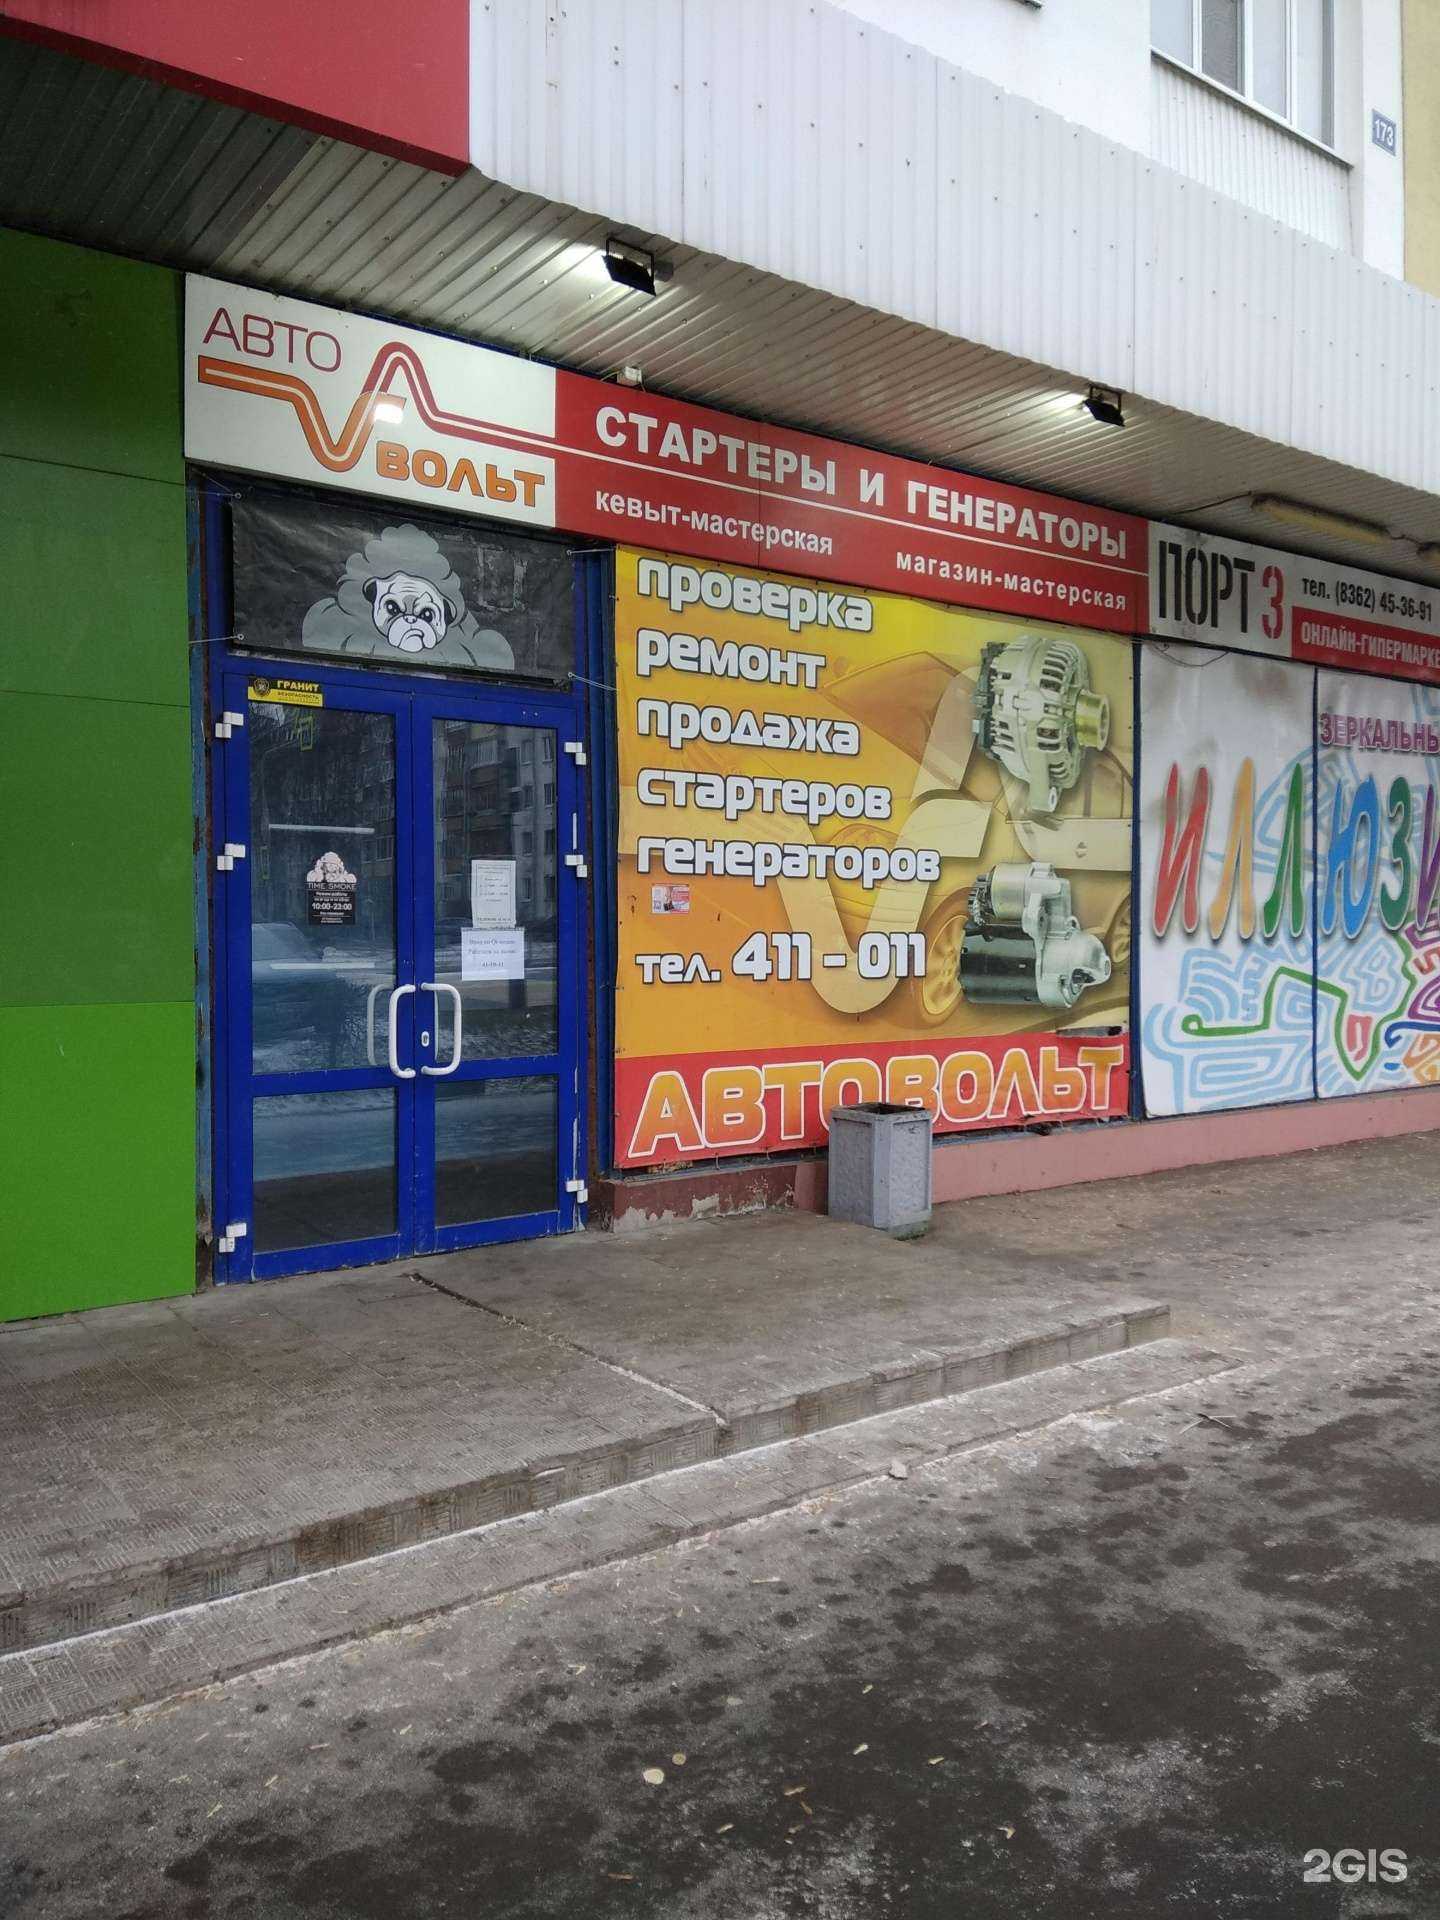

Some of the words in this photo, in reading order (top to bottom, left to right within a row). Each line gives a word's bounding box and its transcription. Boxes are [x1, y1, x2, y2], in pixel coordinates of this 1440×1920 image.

[203, 307, 342, 372] АВТО
[595, 406, 835, 495] СТАРТЕРЫ
[860, 468, 884, 506] И
[907, 480, 1126, 559] ГЕНЕРАТОРЫ
[596, 490, 833, 556] кевыт-мастерская
[896, 552, 1126, 610] магазин-мастерская
[637, 557, 874, 632] проверка
[1302, 578, 1330, 600] тел.
[1335, 580, 1376, 613] (8362)
[1380, 592, 1432, 622] 45-36-91
[277, 680, 319, 692] ГРАНИТ
[636, 627, 826, 688] ремонт
[637, 697, 861, 756] продажа
[637, 767, 892, 825] стартеров
[637, 836, 941, 888] генераторов
[635, 953, 721, 985] тел.
